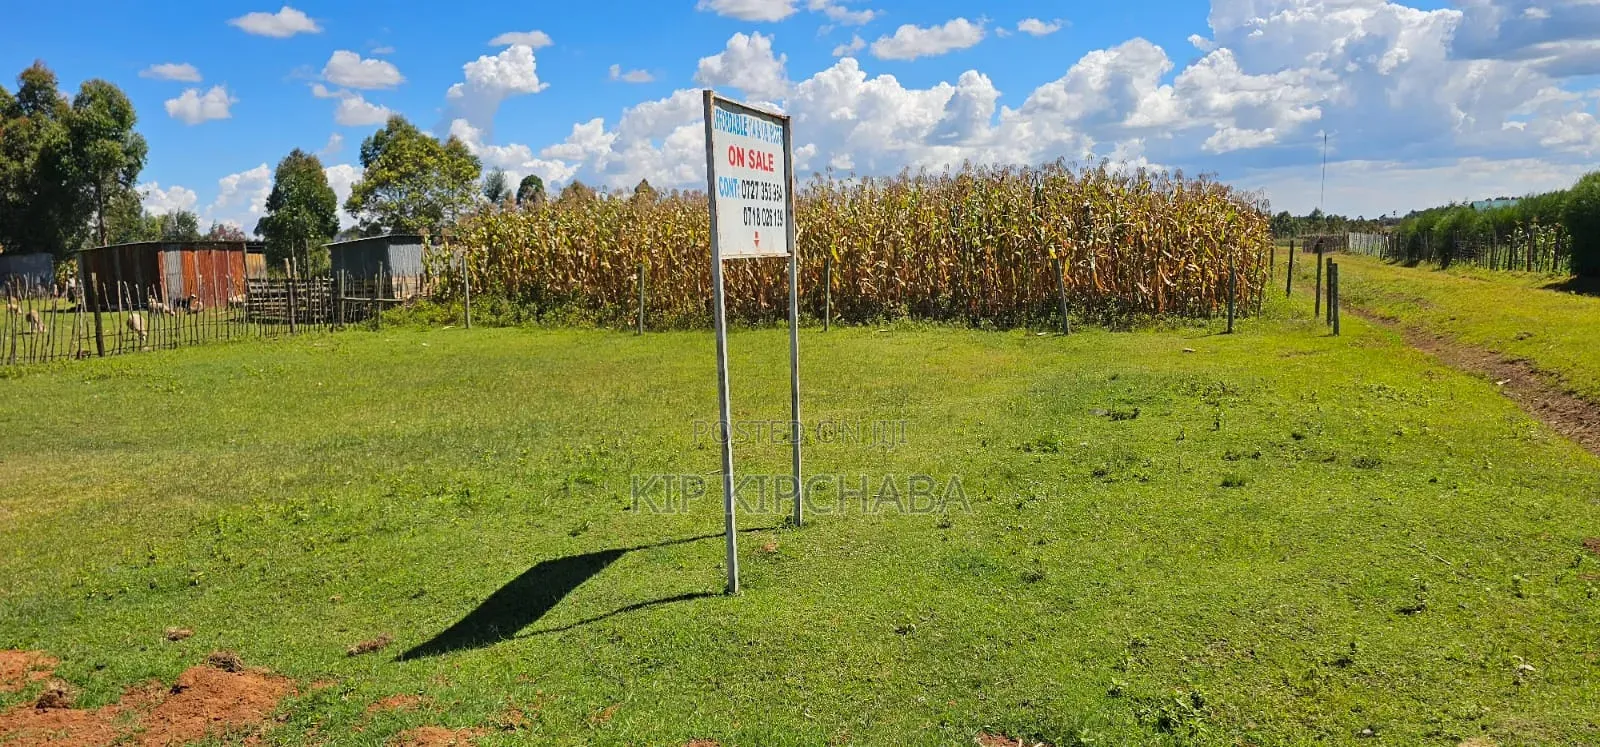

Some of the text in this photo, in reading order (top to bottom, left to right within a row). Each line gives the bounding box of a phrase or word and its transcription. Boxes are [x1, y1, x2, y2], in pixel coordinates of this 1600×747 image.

[728, 145, 775, 172] ON SALE
[718, 176, 740, 200] CONT:
[741, 179, 759, 200] 0727
[743, 207, 761, 226] 0718
